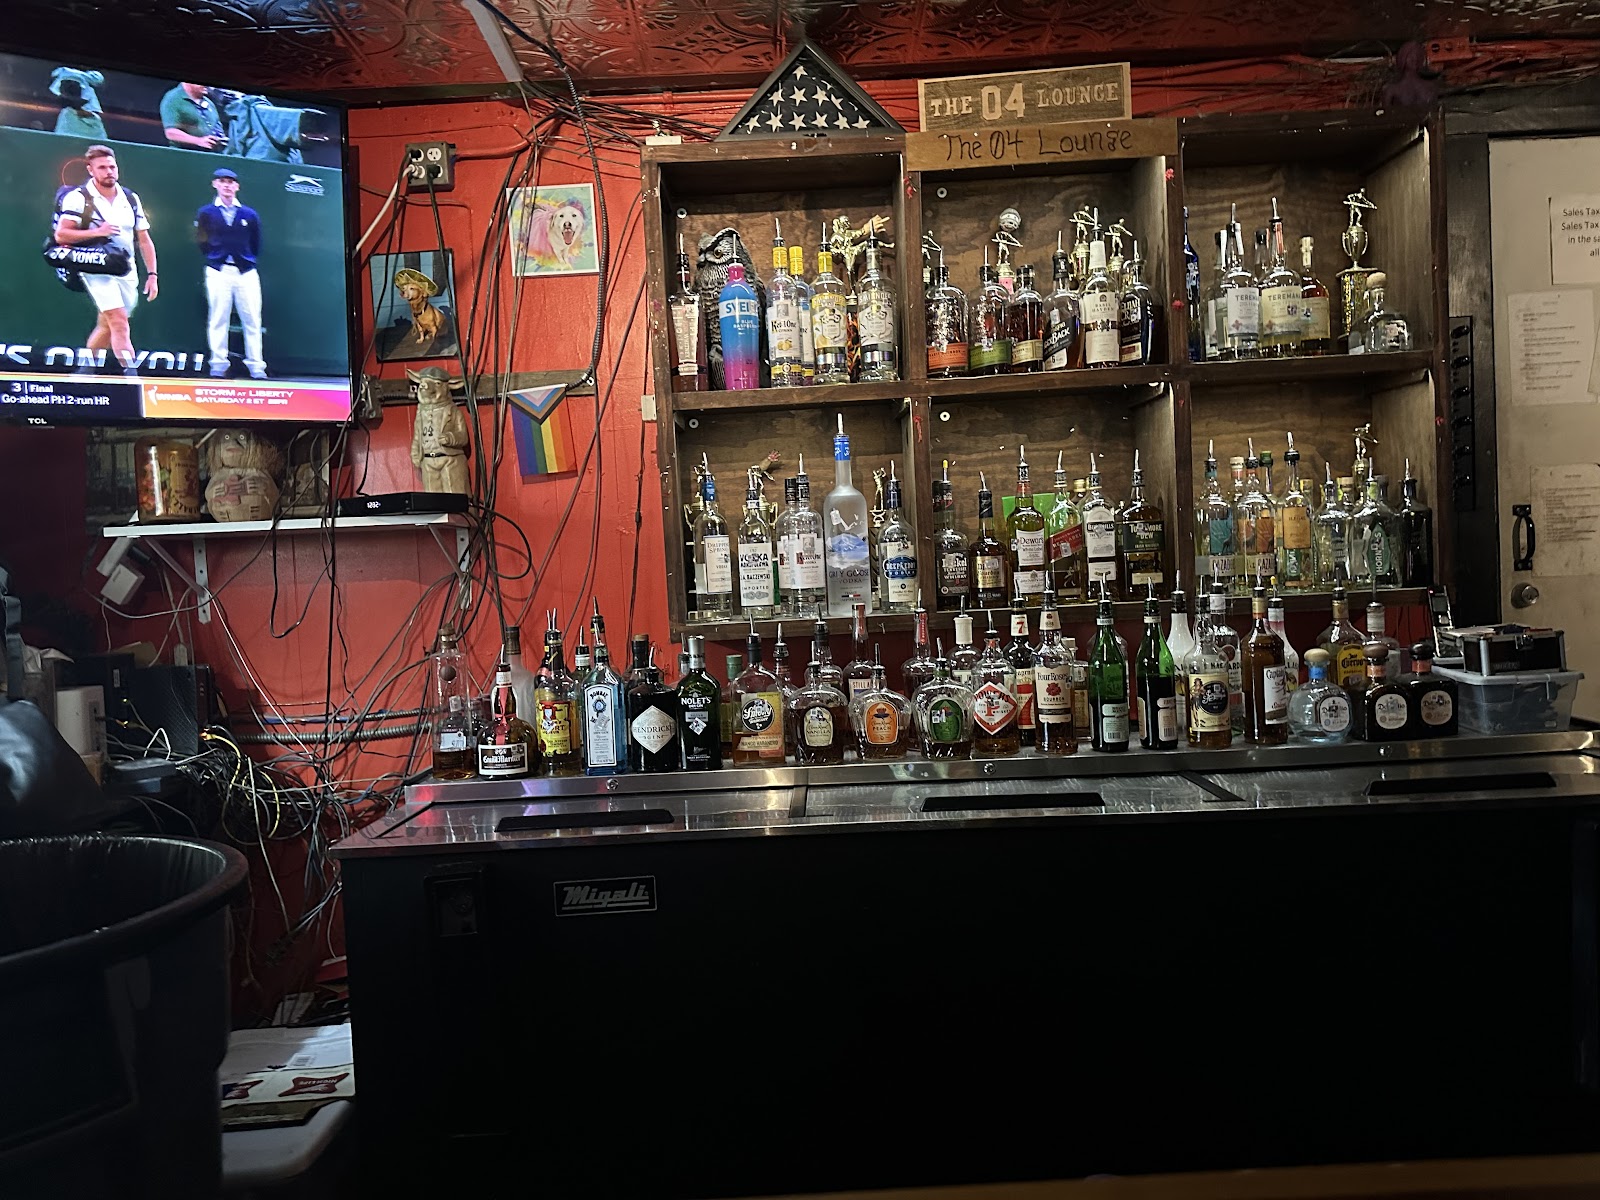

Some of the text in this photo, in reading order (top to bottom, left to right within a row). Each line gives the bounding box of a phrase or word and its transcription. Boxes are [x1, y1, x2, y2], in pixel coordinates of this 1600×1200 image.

[930, 82, 1120, 121] THE 04 LOUNGE
[937, 128, 1134, 161] The 04 Lounge
[1562, 207, 1600, 217] Sales Tax
[1561, 221, 1600, 231] Sales Tax
[1567, 235, 1576, 244] in
[1577, 234, 1591, 244] the
[1589, 247, 1600, 257] all
[71, 249, 108, 266] YONEX
[13, 383, 54, 393] 3 Final
[194, 388, 236, 397] STORM
[249, 389, 294, 398] LIBERTY
[1, 394, 110, 406] Go-ahead PH 2-run HR
[27, 417, 48, 425] TCL
[1015, 621, 1025, 634] 7
[1037, 672, 1050, 681] Four
[589, 690, 609, 700] BOMBAY
[680, 696, 712, 706] NOLET'S
[562, 881, 648, 908] Migali
